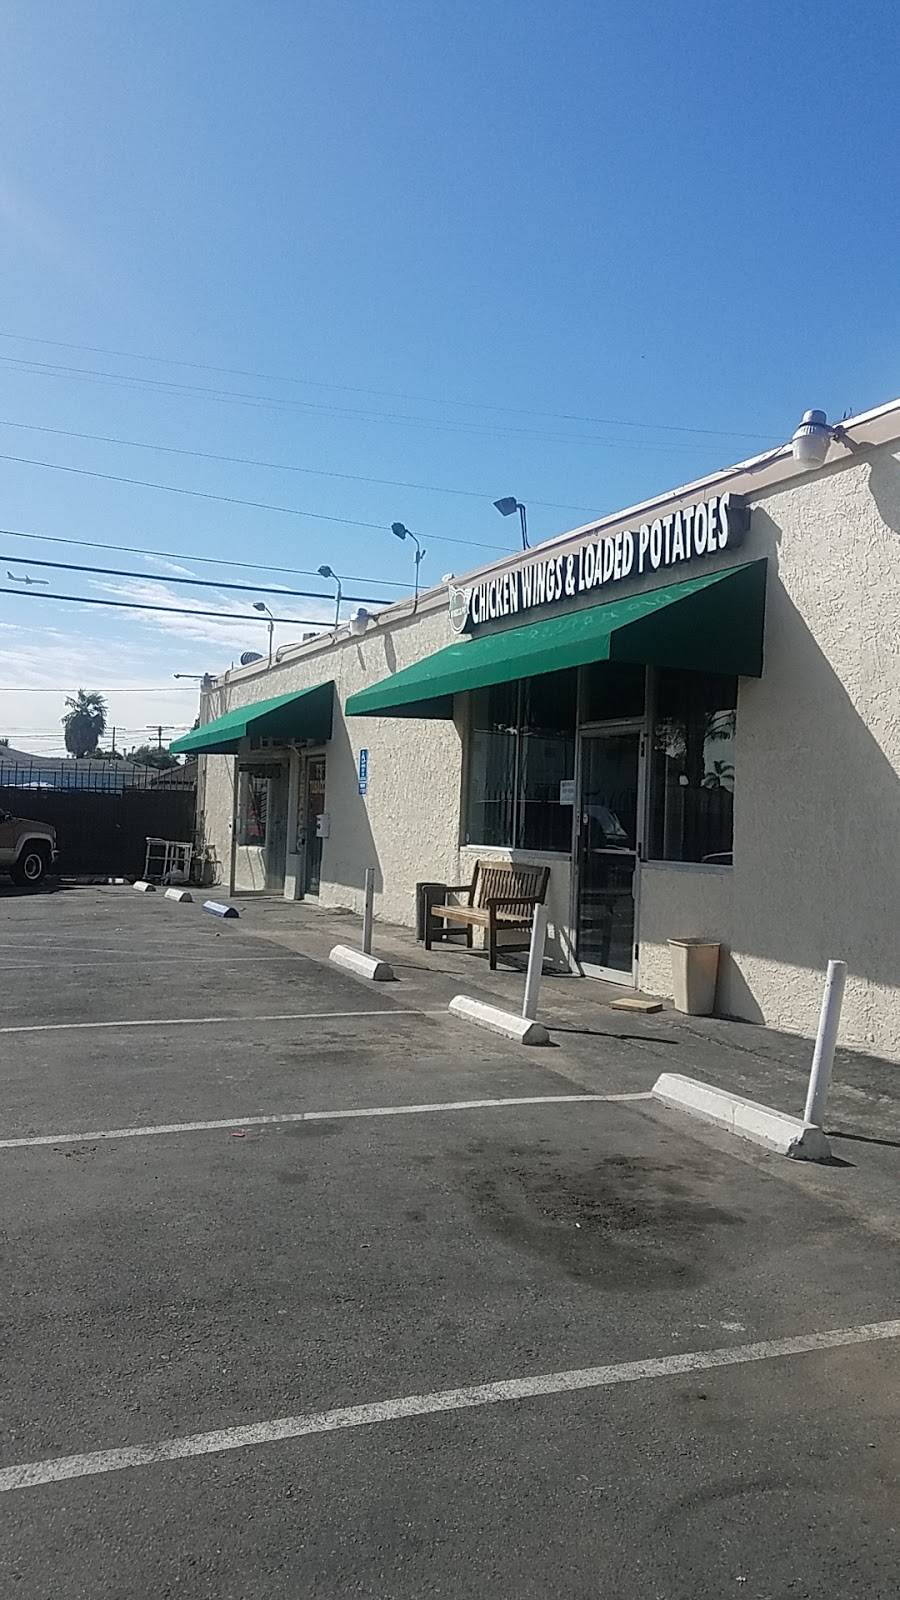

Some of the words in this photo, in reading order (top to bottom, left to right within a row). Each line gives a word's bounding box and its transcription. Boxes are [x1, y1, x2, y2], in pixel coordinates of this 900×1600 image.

[470, 571, 518, 624] CHICKEN
[521, 556, 563, 609] WINGS
[566, 554, 576, 596] &
[578, 533, 634, 591] LOADED
[638, 493, 730, 573] POTATOES
